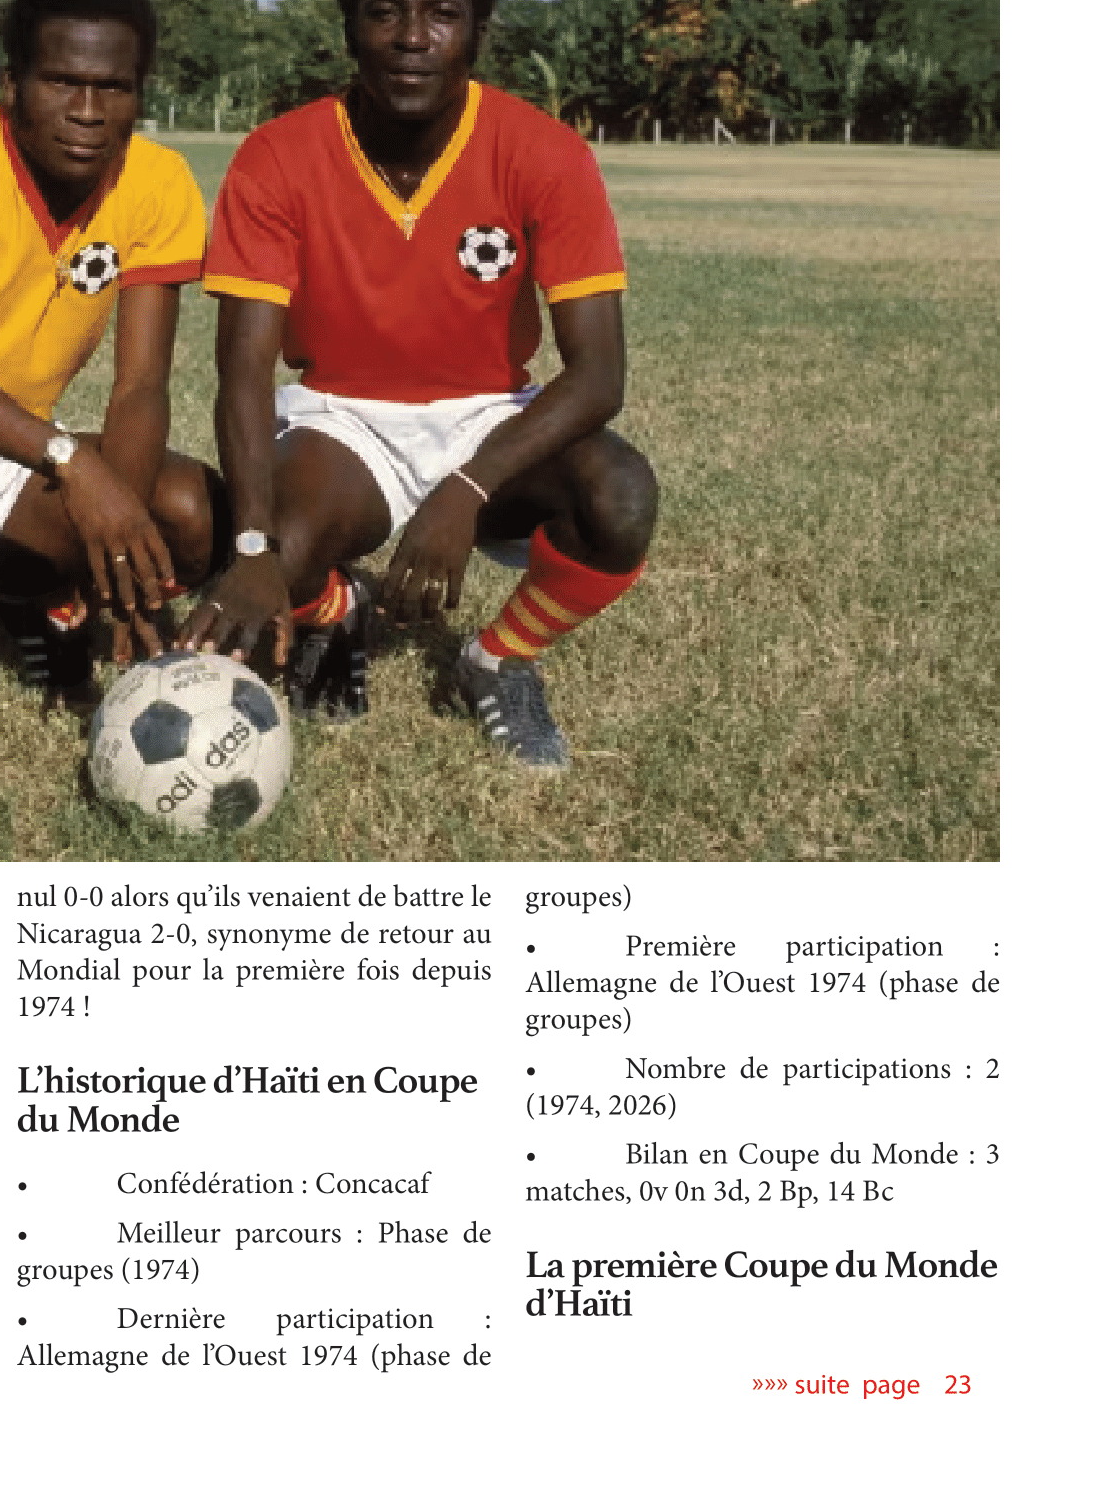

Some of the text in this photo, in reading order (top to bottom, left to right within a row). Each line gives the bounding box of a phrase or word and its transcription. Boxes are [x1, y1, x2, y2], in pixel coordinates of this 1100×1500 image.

[17, 921, 491, 951] Nicaragua 2-0, synonyme de retour au
[18, 1065, 477, 1102] L’historique d’Haïti en Coupe
[18, 1104, 179, 1132] du Monde
[527, 1093, 675, 1120] (1974, 2026)
[118, 1171, 293, 1194] Confédération
[316, 1171, 432, 1194] Concacaf
[526, 1179, 893, 1208] matches, 0v 0n 3d, 2 Bp, 14 Bc
[526, 1250, 997, 1287] La première Coupe du Monde
[526, 1288, 632, 1316] d’Haïti
[795, 1375, 971, 1400] suite page 23
